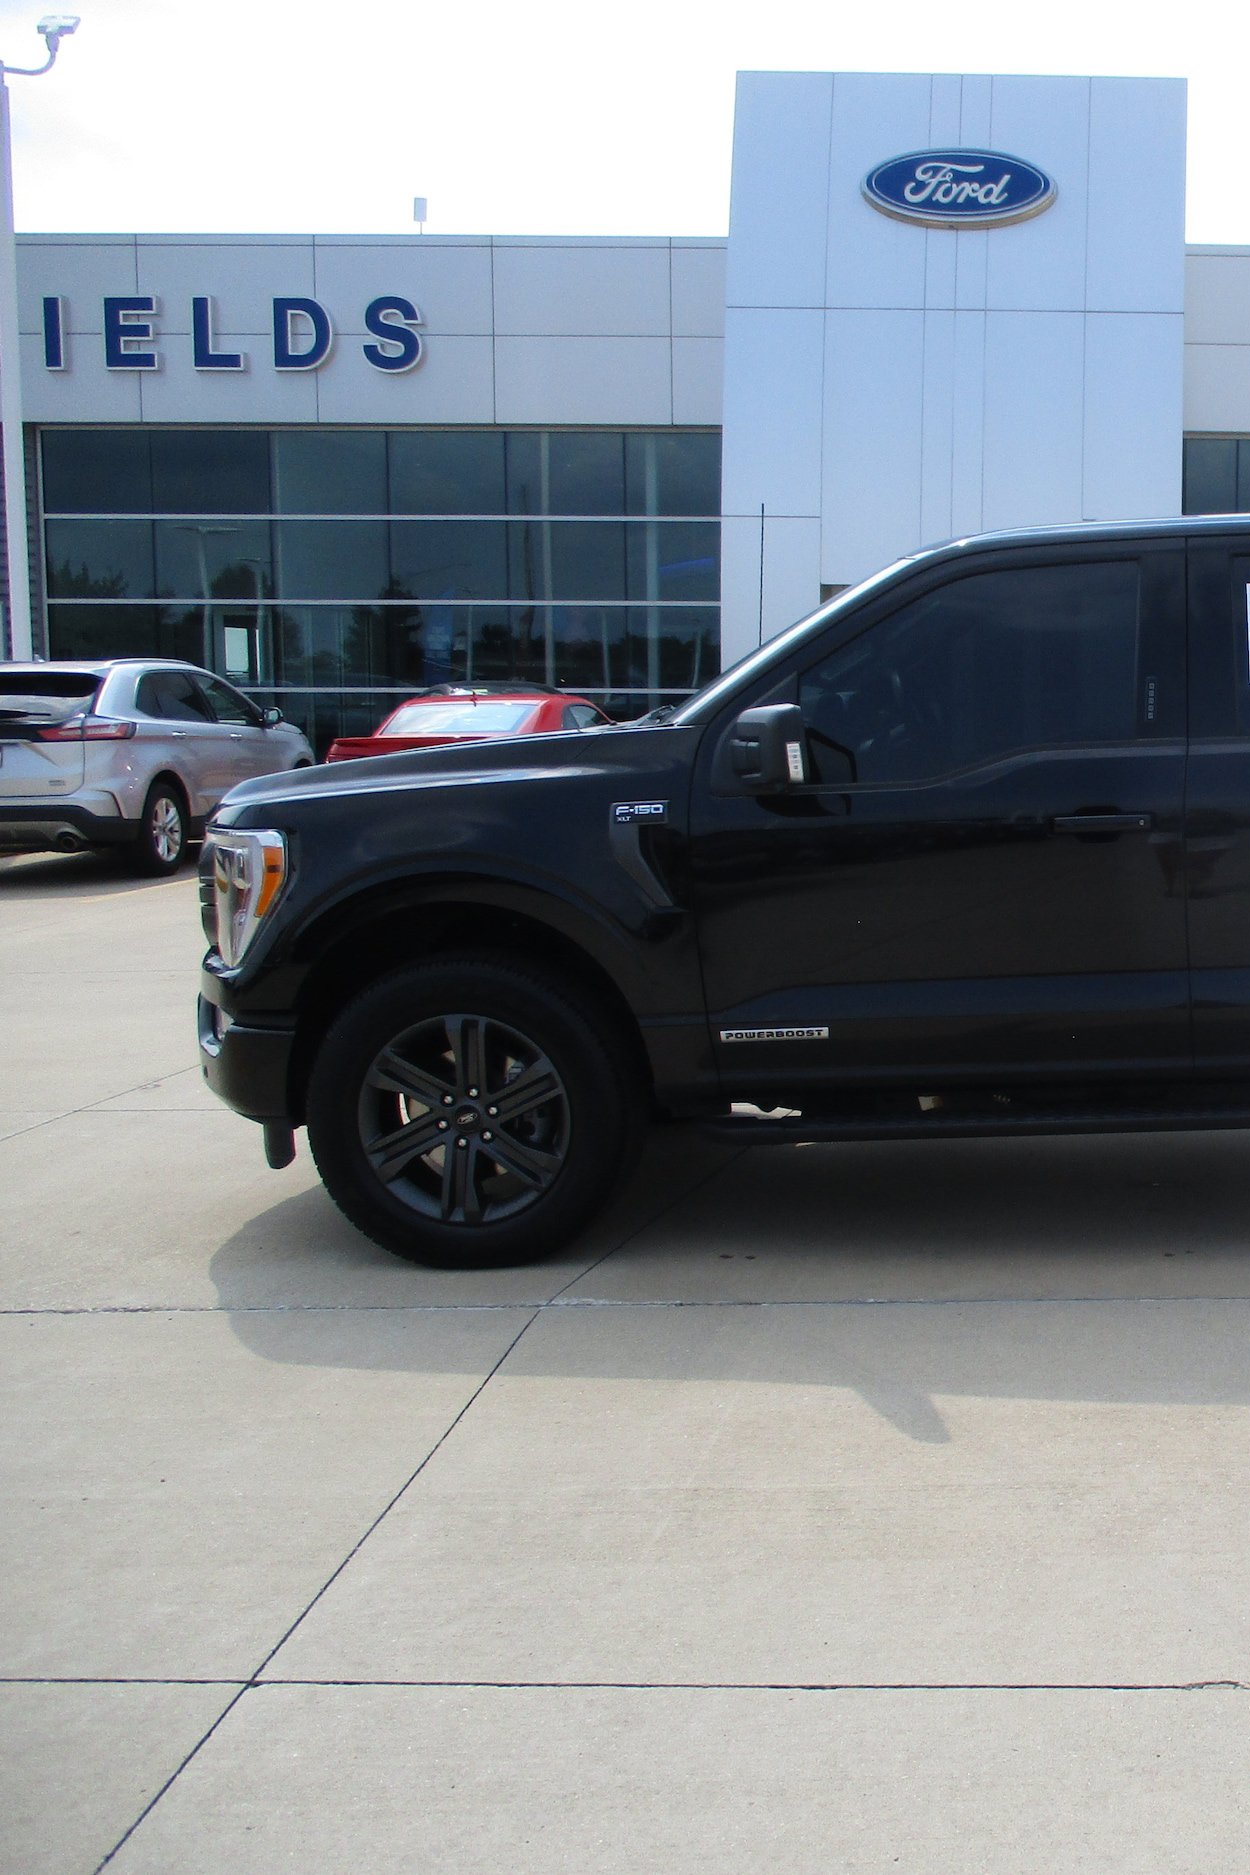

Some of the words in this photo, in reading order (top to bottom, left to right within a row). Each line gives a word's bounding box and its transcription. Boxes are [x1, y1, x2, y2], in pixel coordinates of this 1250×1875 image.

[904, 162, 1011, 204] Ford
[616, 804, 664, 815] F-150
[725, 1029, 824, 1039] POWERBOOST
